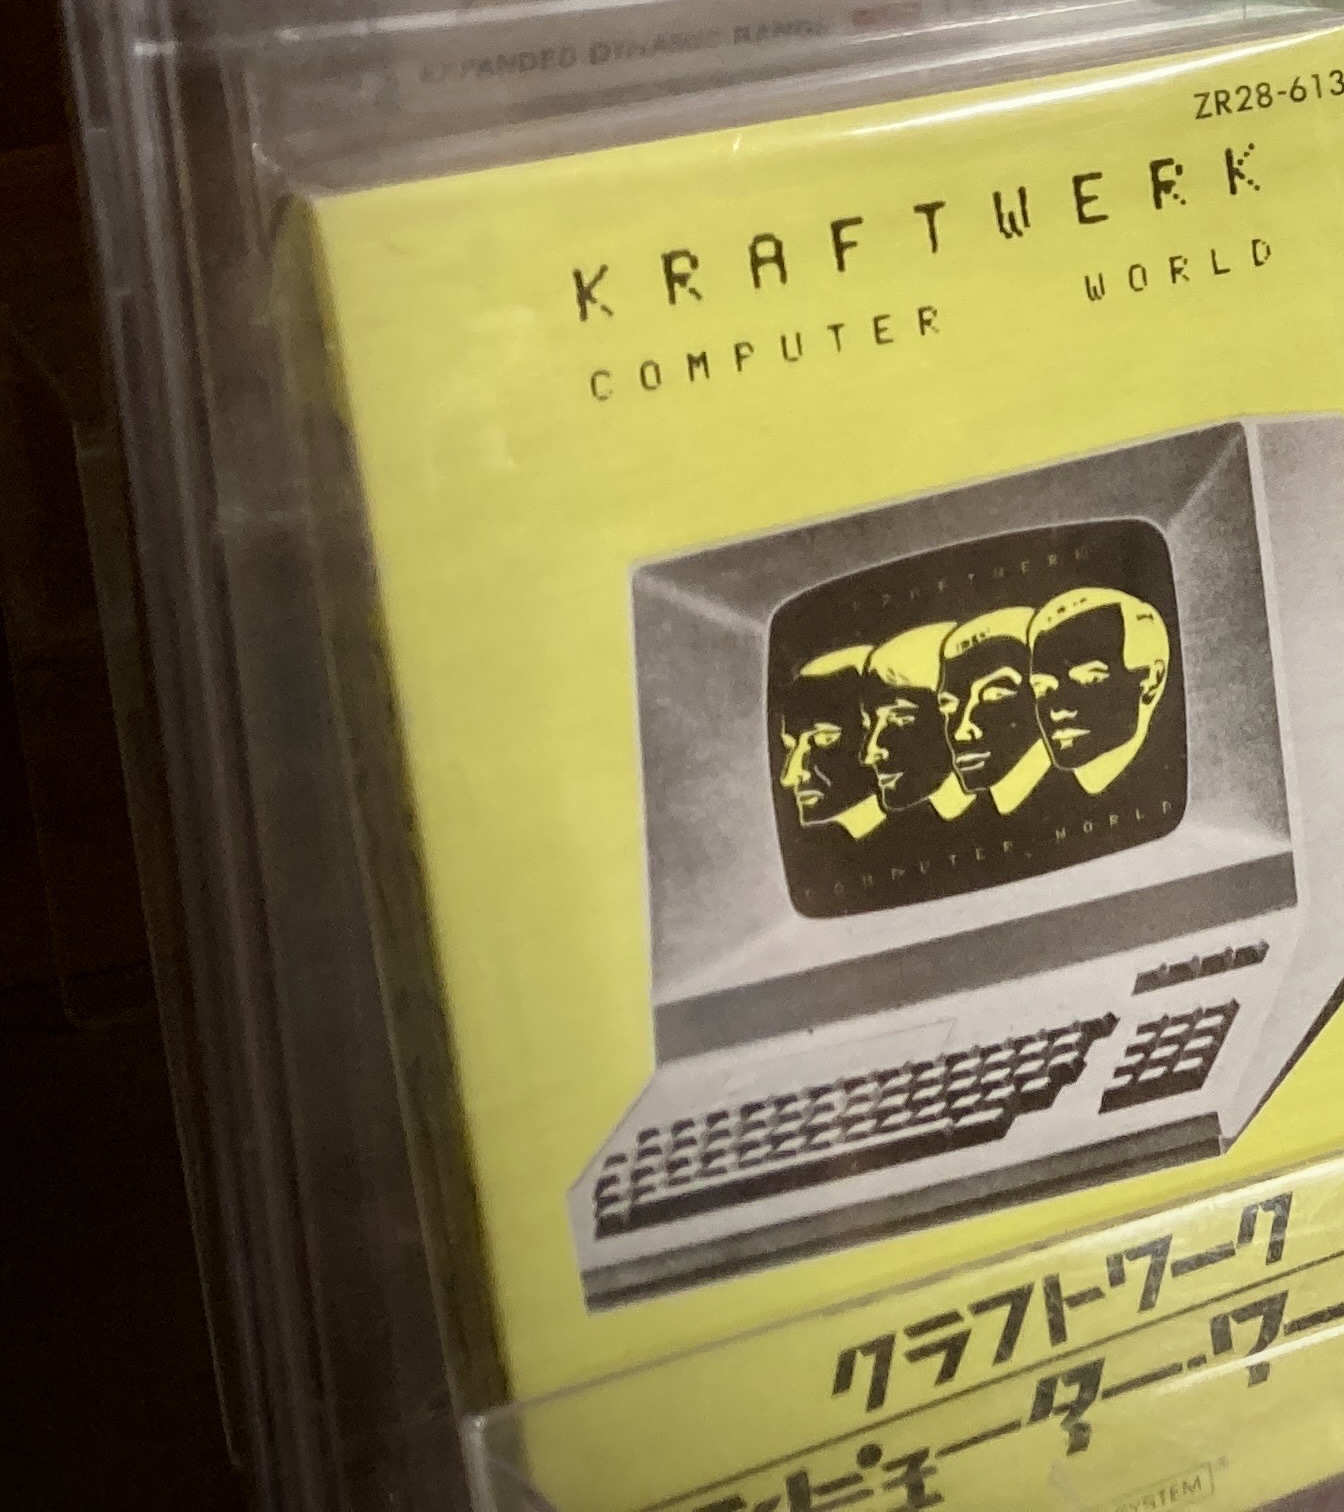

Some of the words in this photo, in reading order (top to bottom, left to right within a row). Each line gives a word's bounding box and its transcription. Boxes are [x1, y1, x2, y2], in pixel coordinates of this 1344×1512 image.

[572, 142, 1263, 323] KRAFTWERK
[589, 305, 943, 402] COMPUTER
[1085, 238, 1274, 302] WORLD
[832, 1192, 1295, 1412] クラフトワーク
